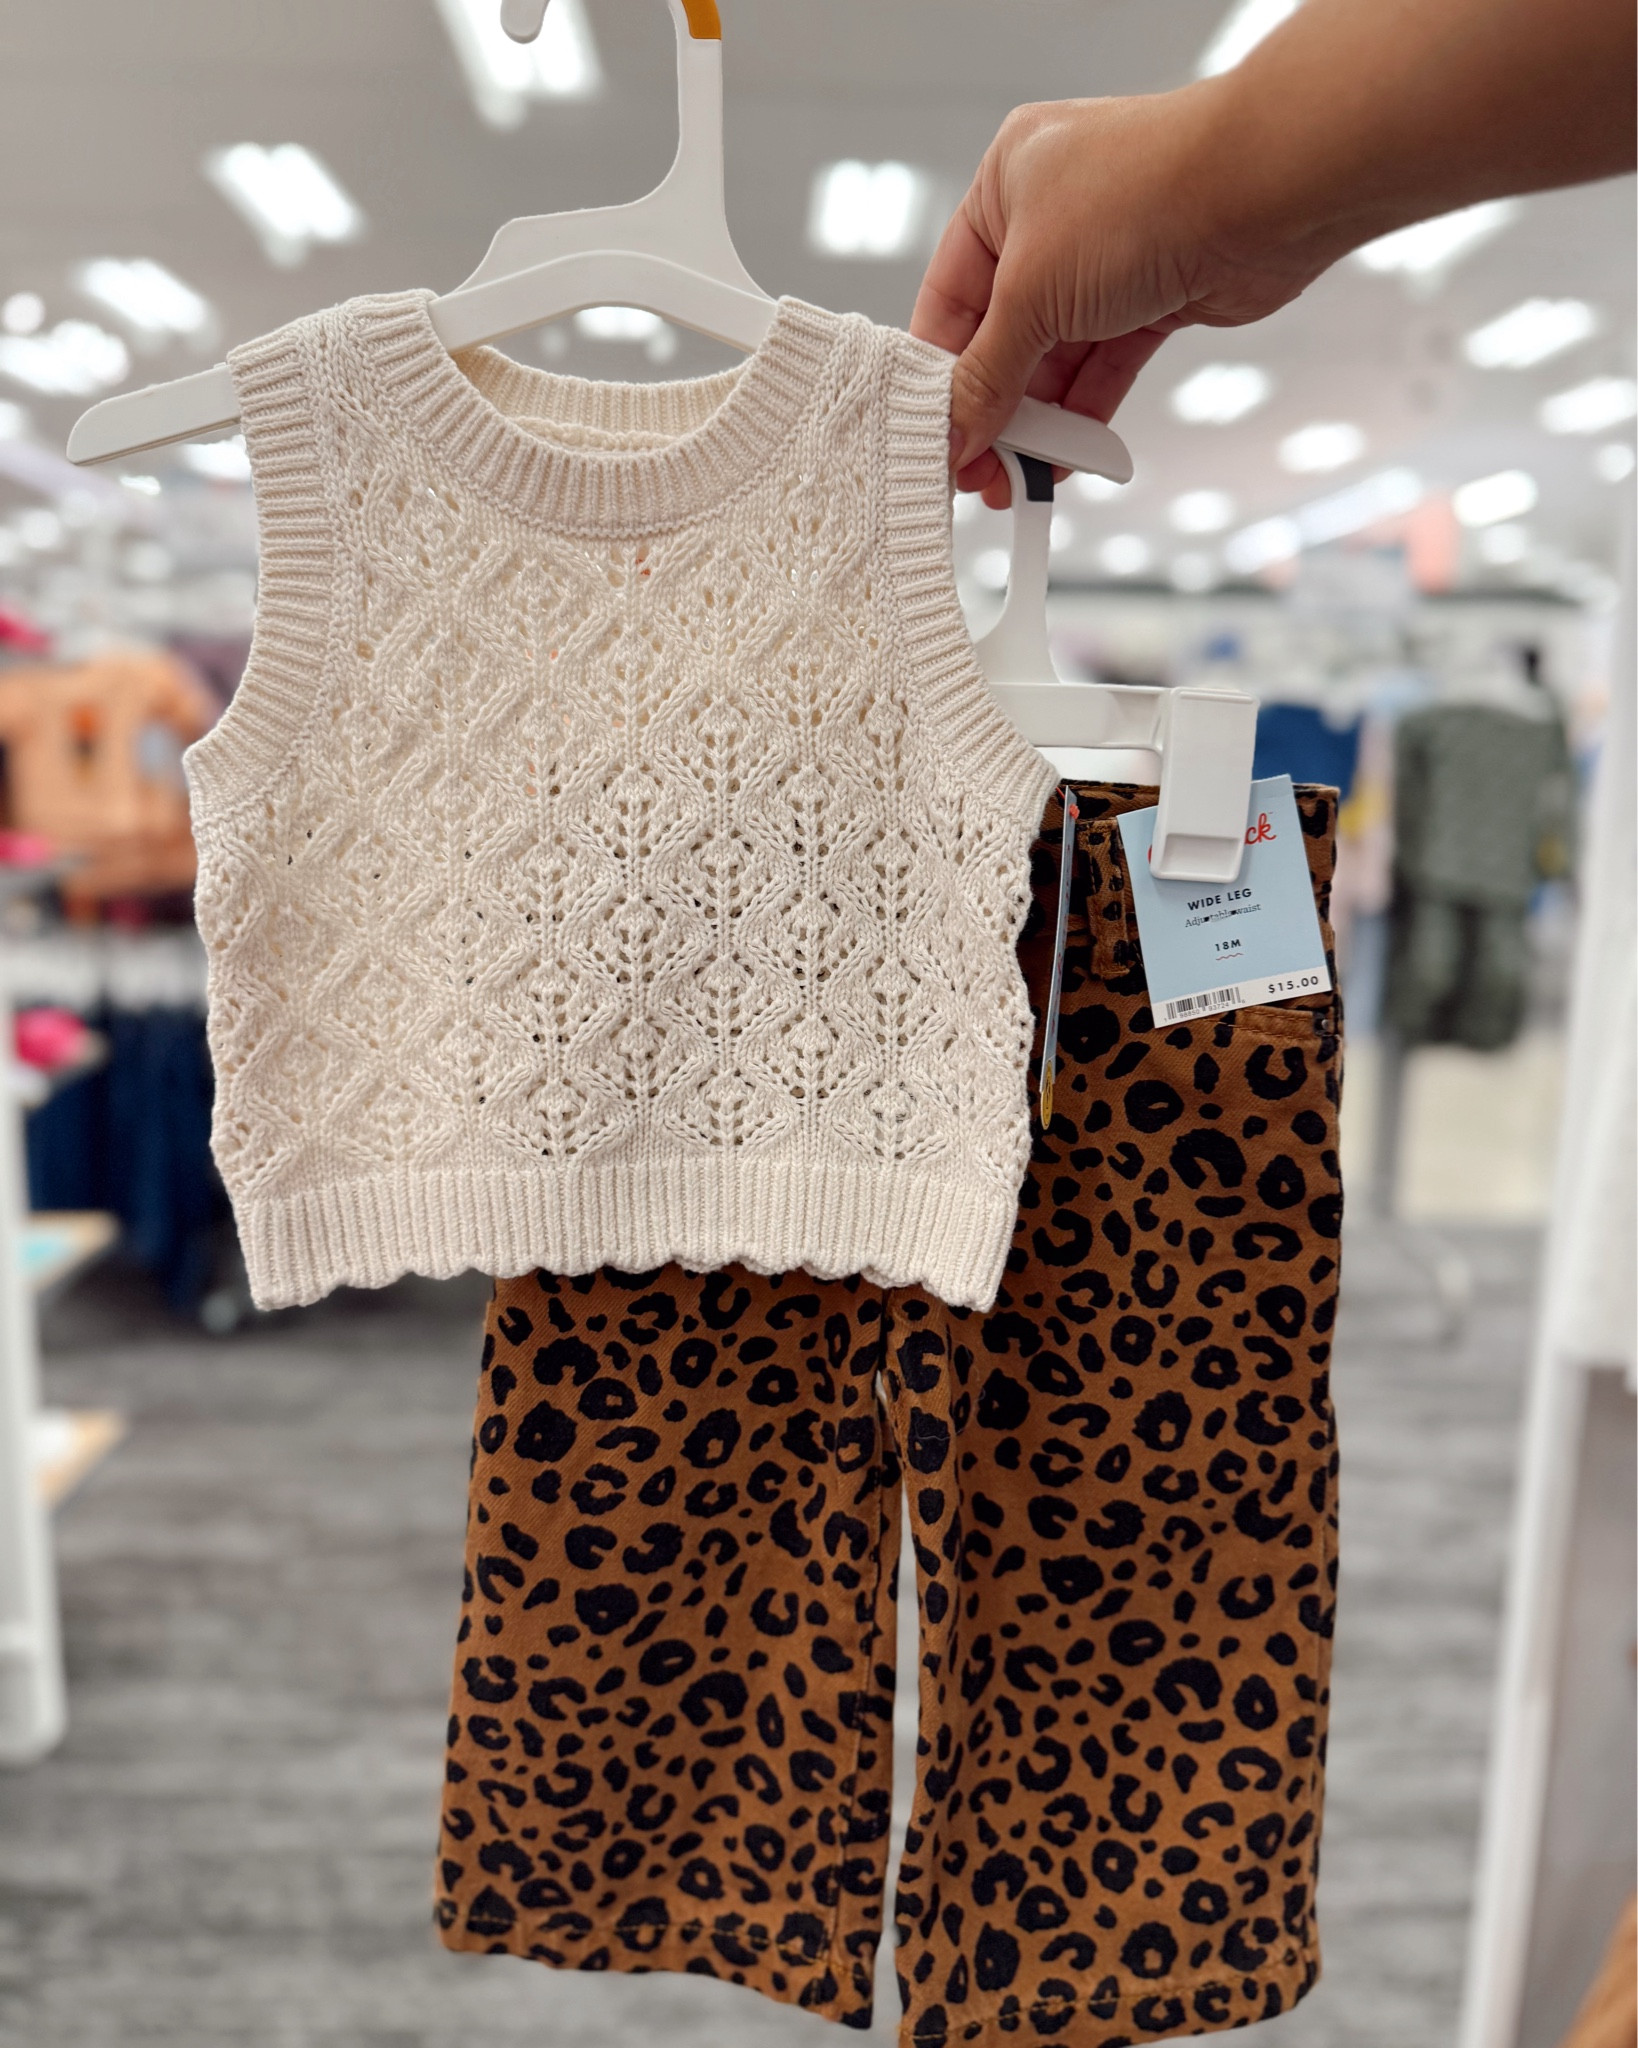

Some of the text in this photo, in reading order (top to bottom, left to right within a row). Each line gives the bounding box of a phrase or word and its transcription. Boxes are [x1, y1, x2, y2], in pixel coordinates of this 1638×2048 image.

[1187, 888, 1252, 911] WIDE LEG
[1235, 904, 1261, 915] waist
[1215, 939, 1242, 952] 18M
[1268, 975, 1319, 994] $15.00
